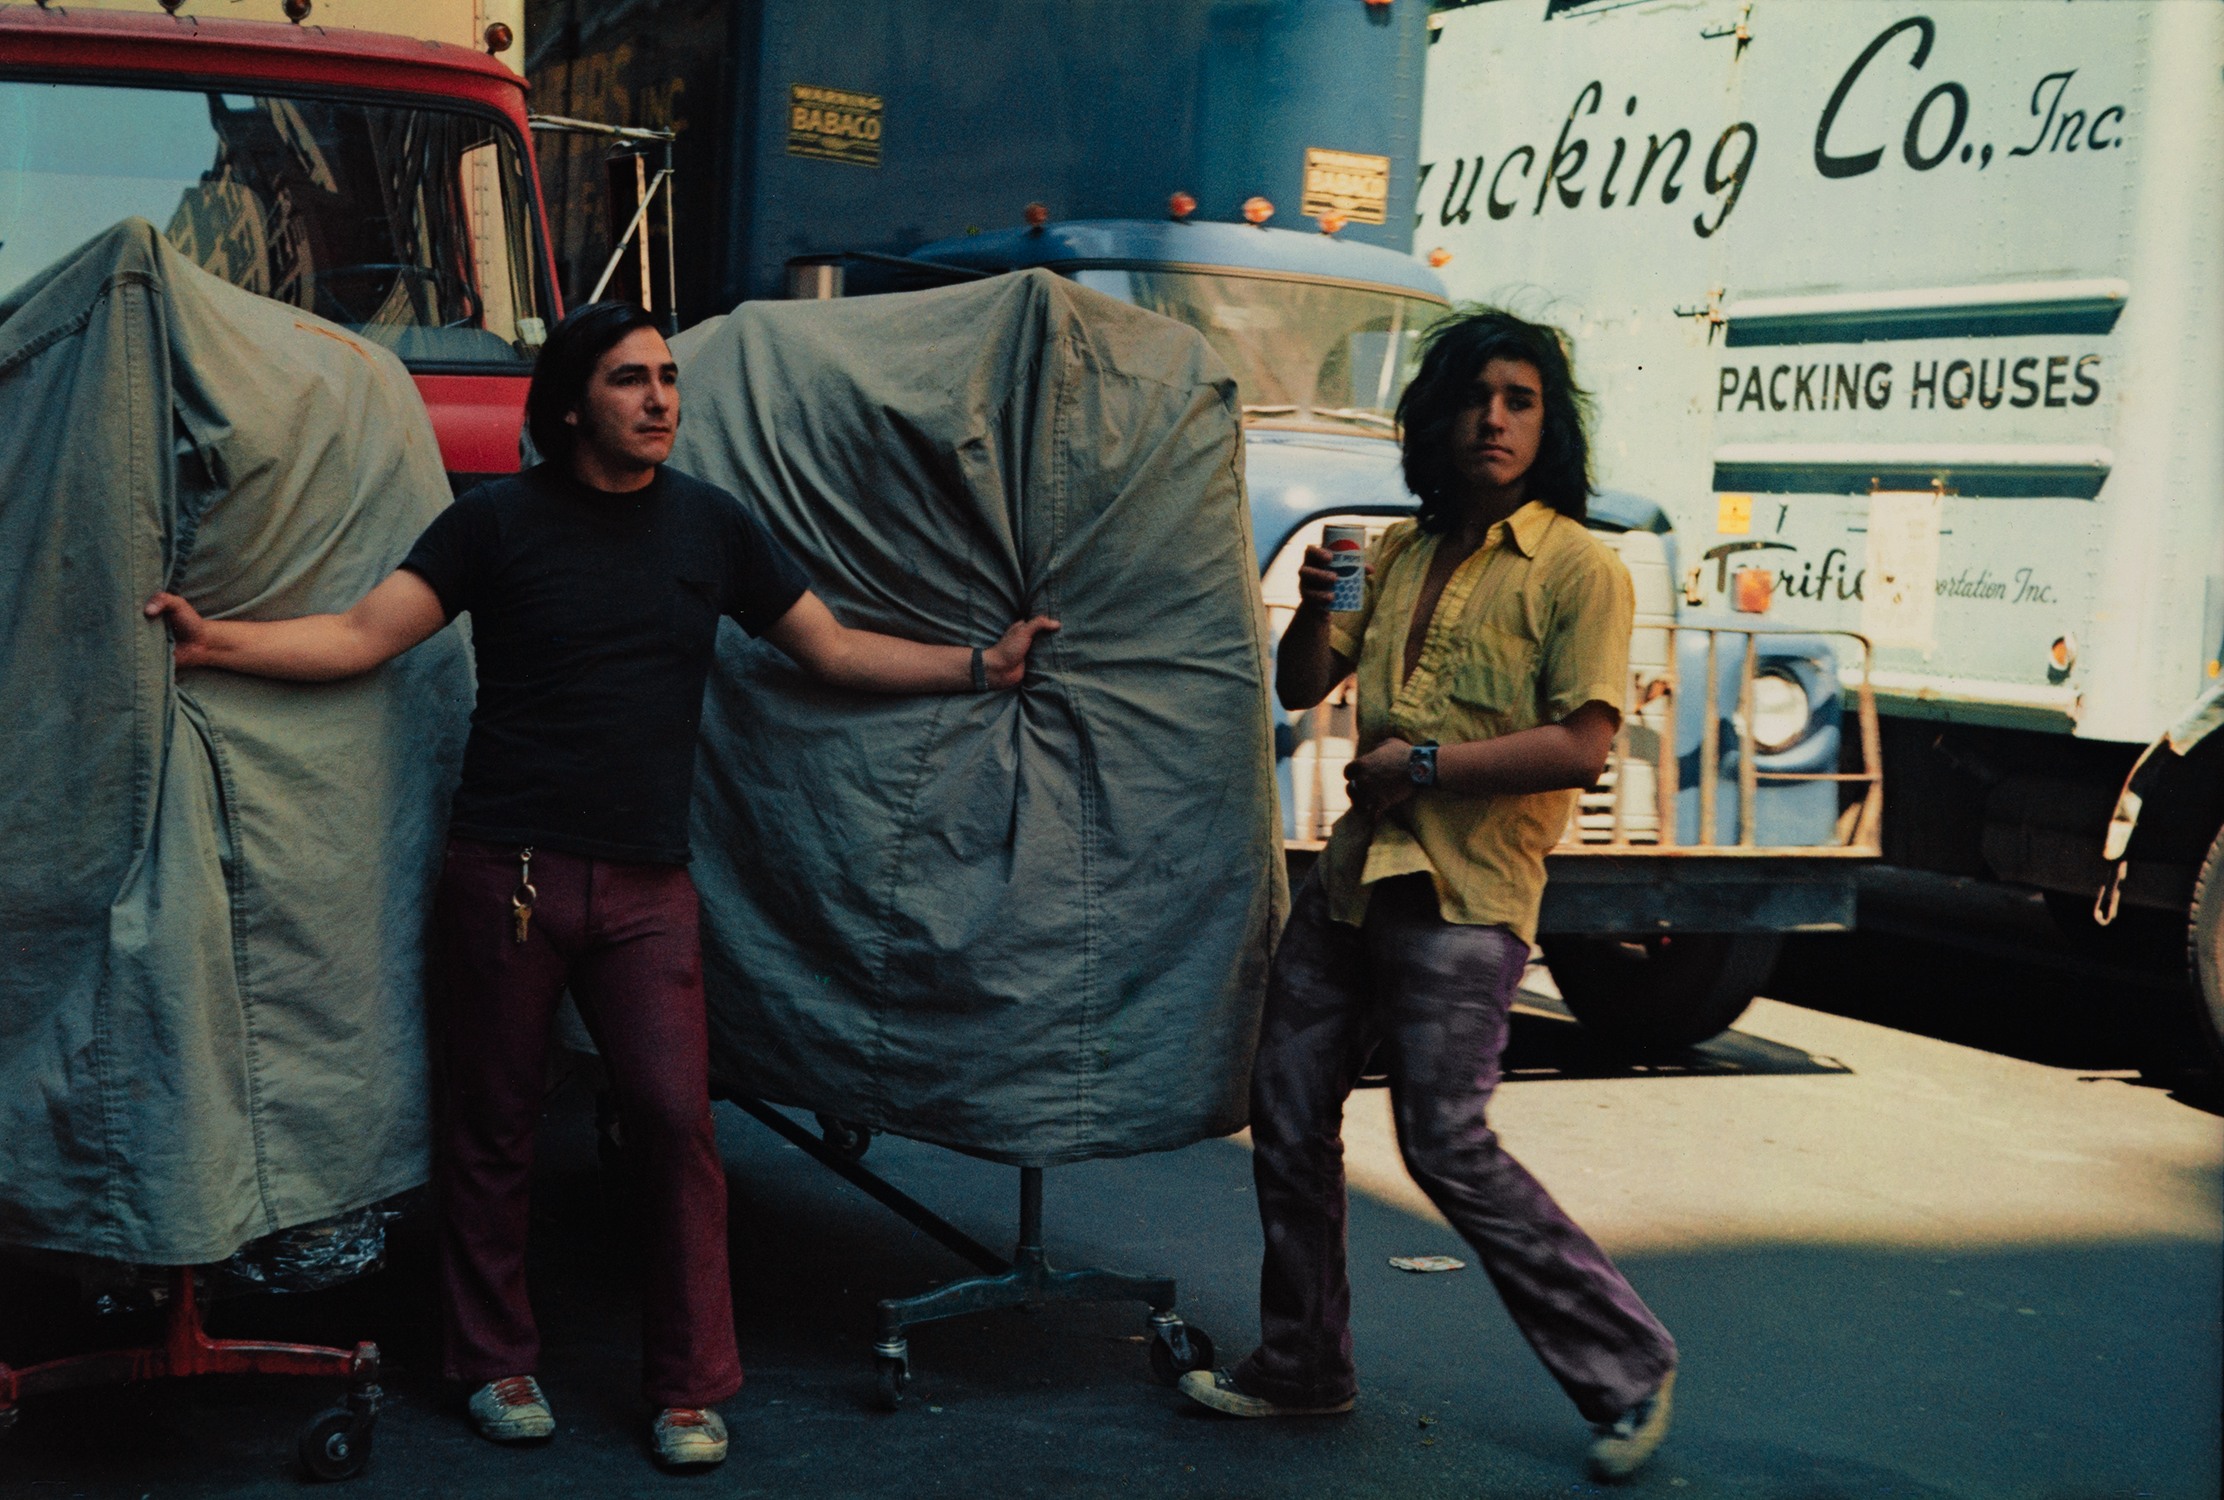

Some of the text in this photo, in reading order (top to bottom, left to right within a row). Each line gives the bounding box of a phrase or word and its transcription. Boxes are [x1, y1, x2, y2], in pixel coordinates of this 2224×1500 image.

[792, 105, 881, 140] BABACO
[1814, 16, 1994, 179] Co.,
[2009, 68, 2125, 158] Inc.
[1717, 353, 2102, 412] PACKING HOUSES
[1704, 541, 1866, 602] Trific
[2012, 567, 2057, 604] Inc.
